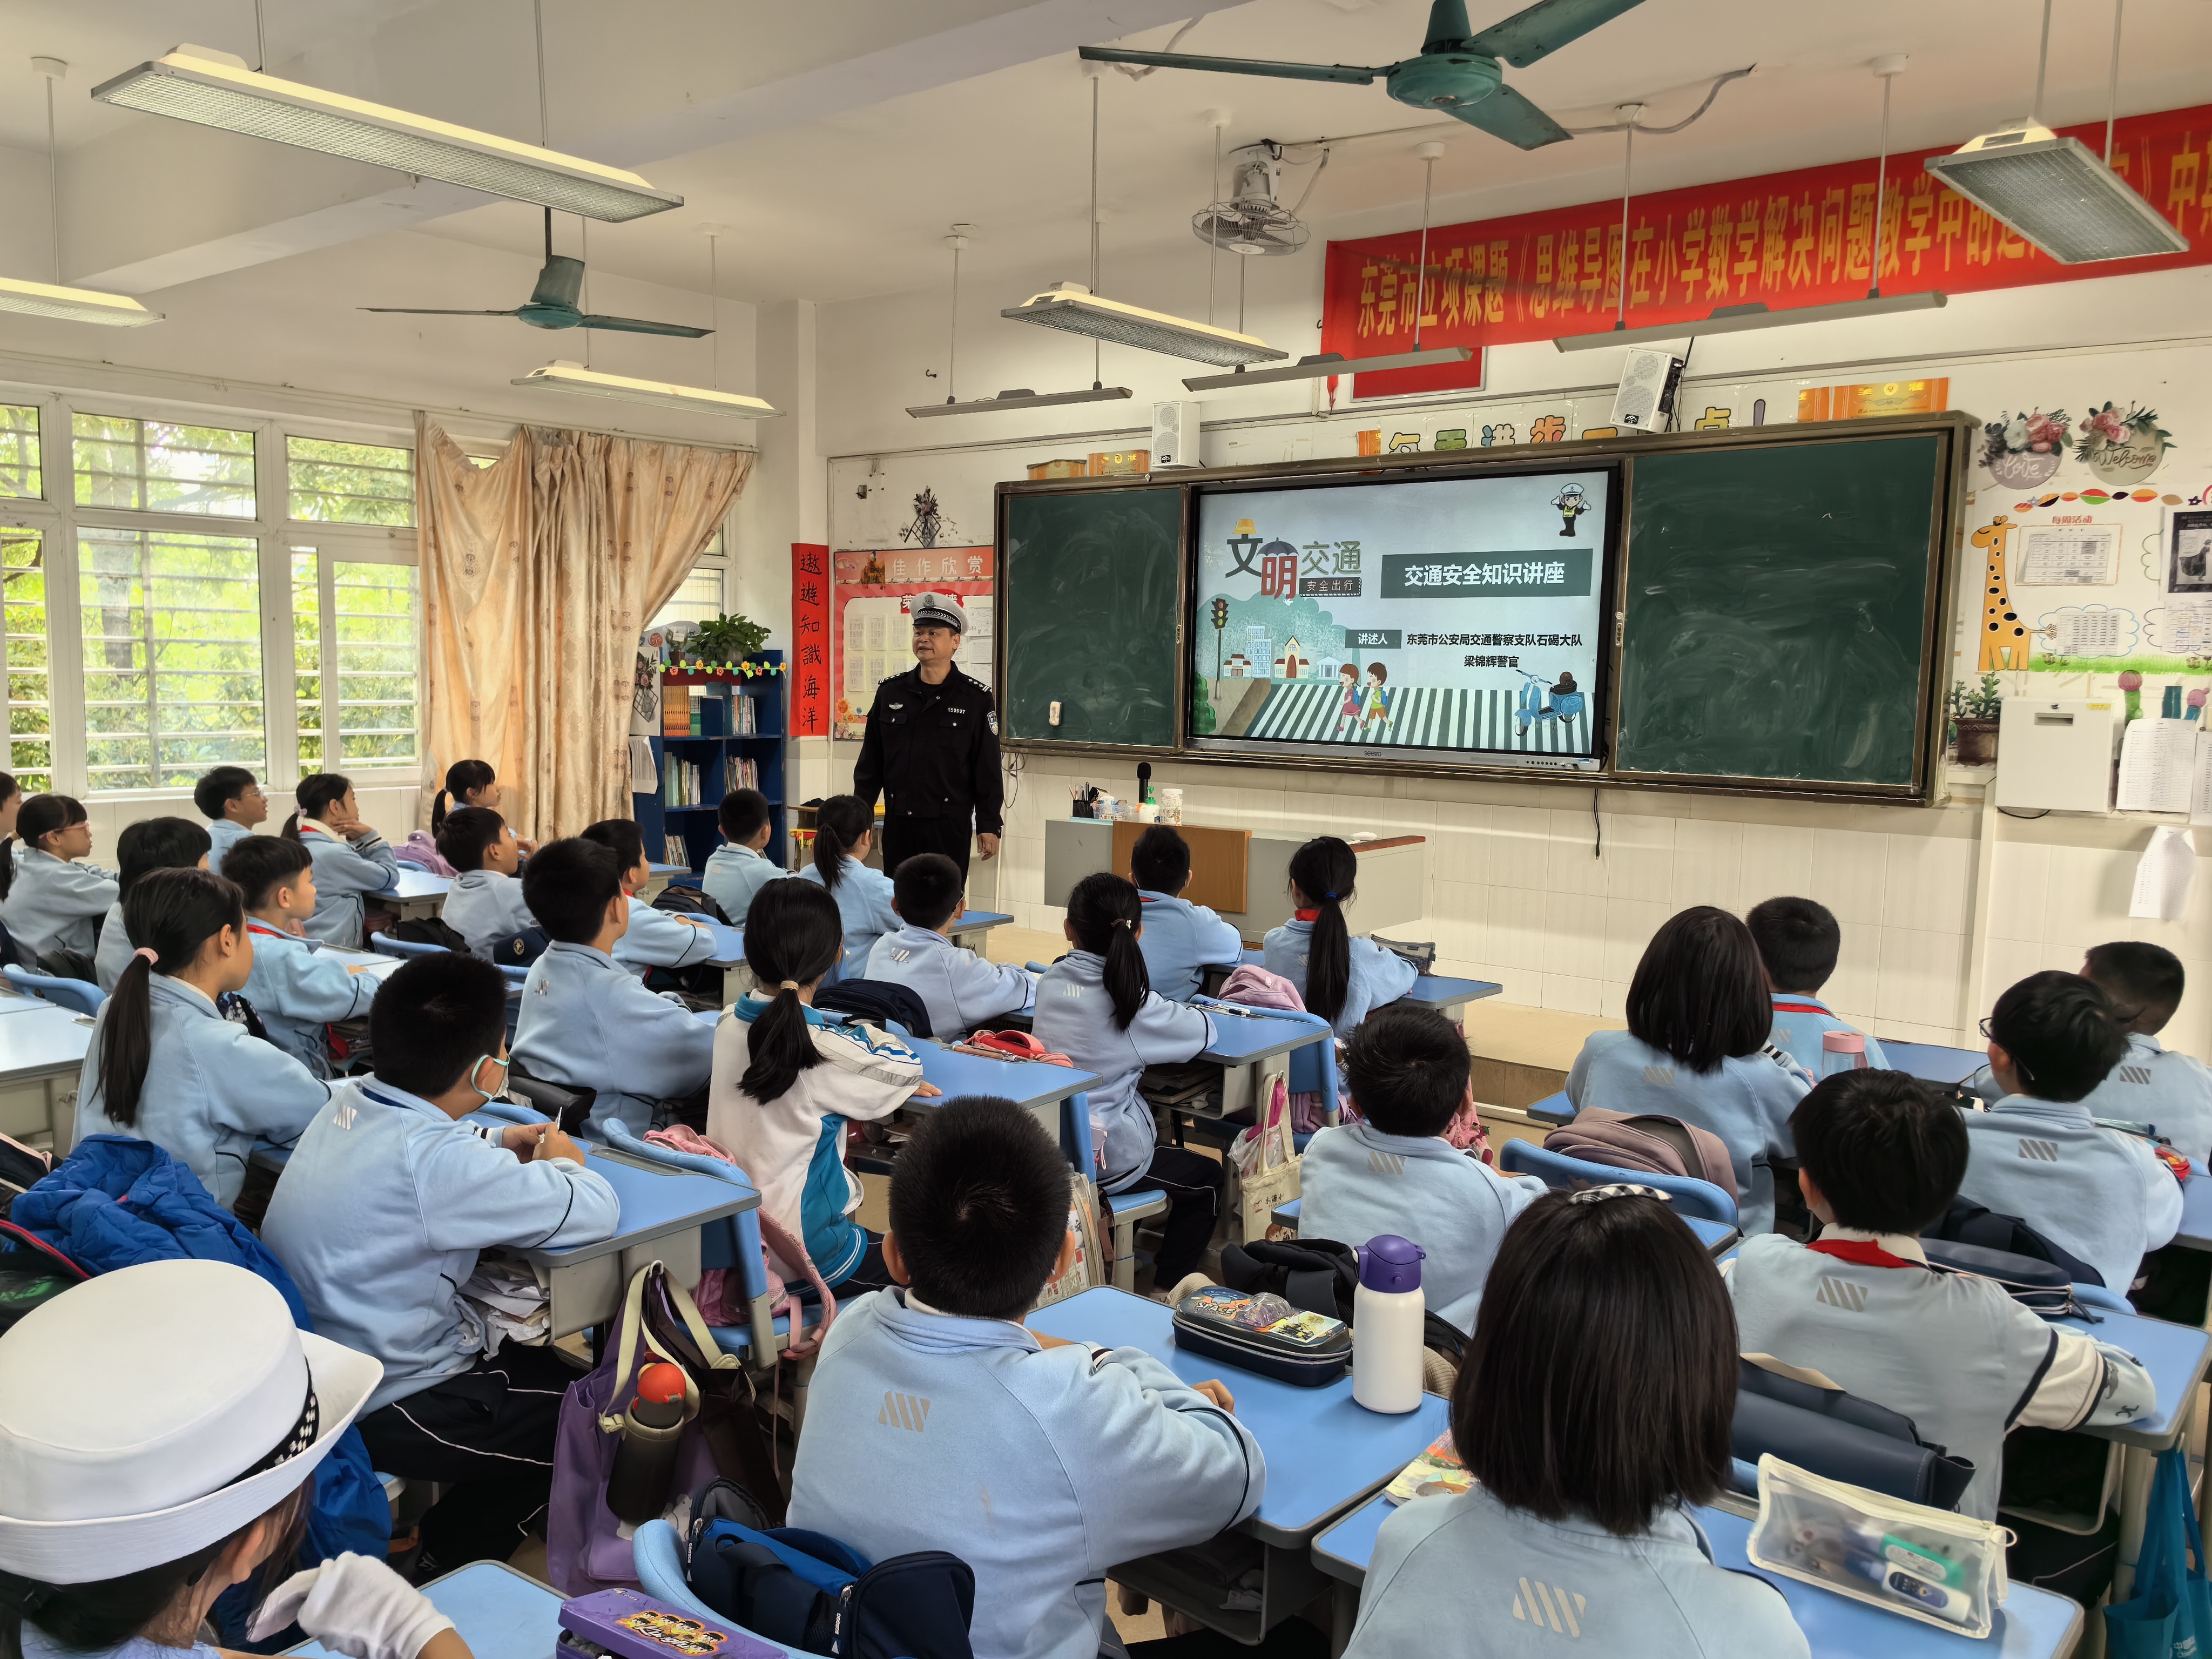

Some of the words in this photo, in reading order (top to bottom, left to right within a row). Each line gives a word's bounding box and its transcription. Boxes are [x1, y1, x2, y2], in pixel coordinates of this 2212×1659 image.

[2093, 446, 2156, 469] Welcome
[2052, 516, 2093, 524] 每周活动
[892, 555, 983, 576] 佳作欣赏
[1225, 534, 1361, 599] 文明交通
[1404, 561, 1565, 586] 交通安全知识讲座
[1307, 579, 1353, 591] 安全出行
[799, 553, 822, 733] 遨遊知識海洋
[1358, 632, 1388, 645] 讲述人
[1407, 633, 1582, 646] 东莞市公安局交通警察支队石碣大队
[1464, 655, 1519, 667] 梁锦辉警官
[1196, 1301, 1237, 1314] SPACE
